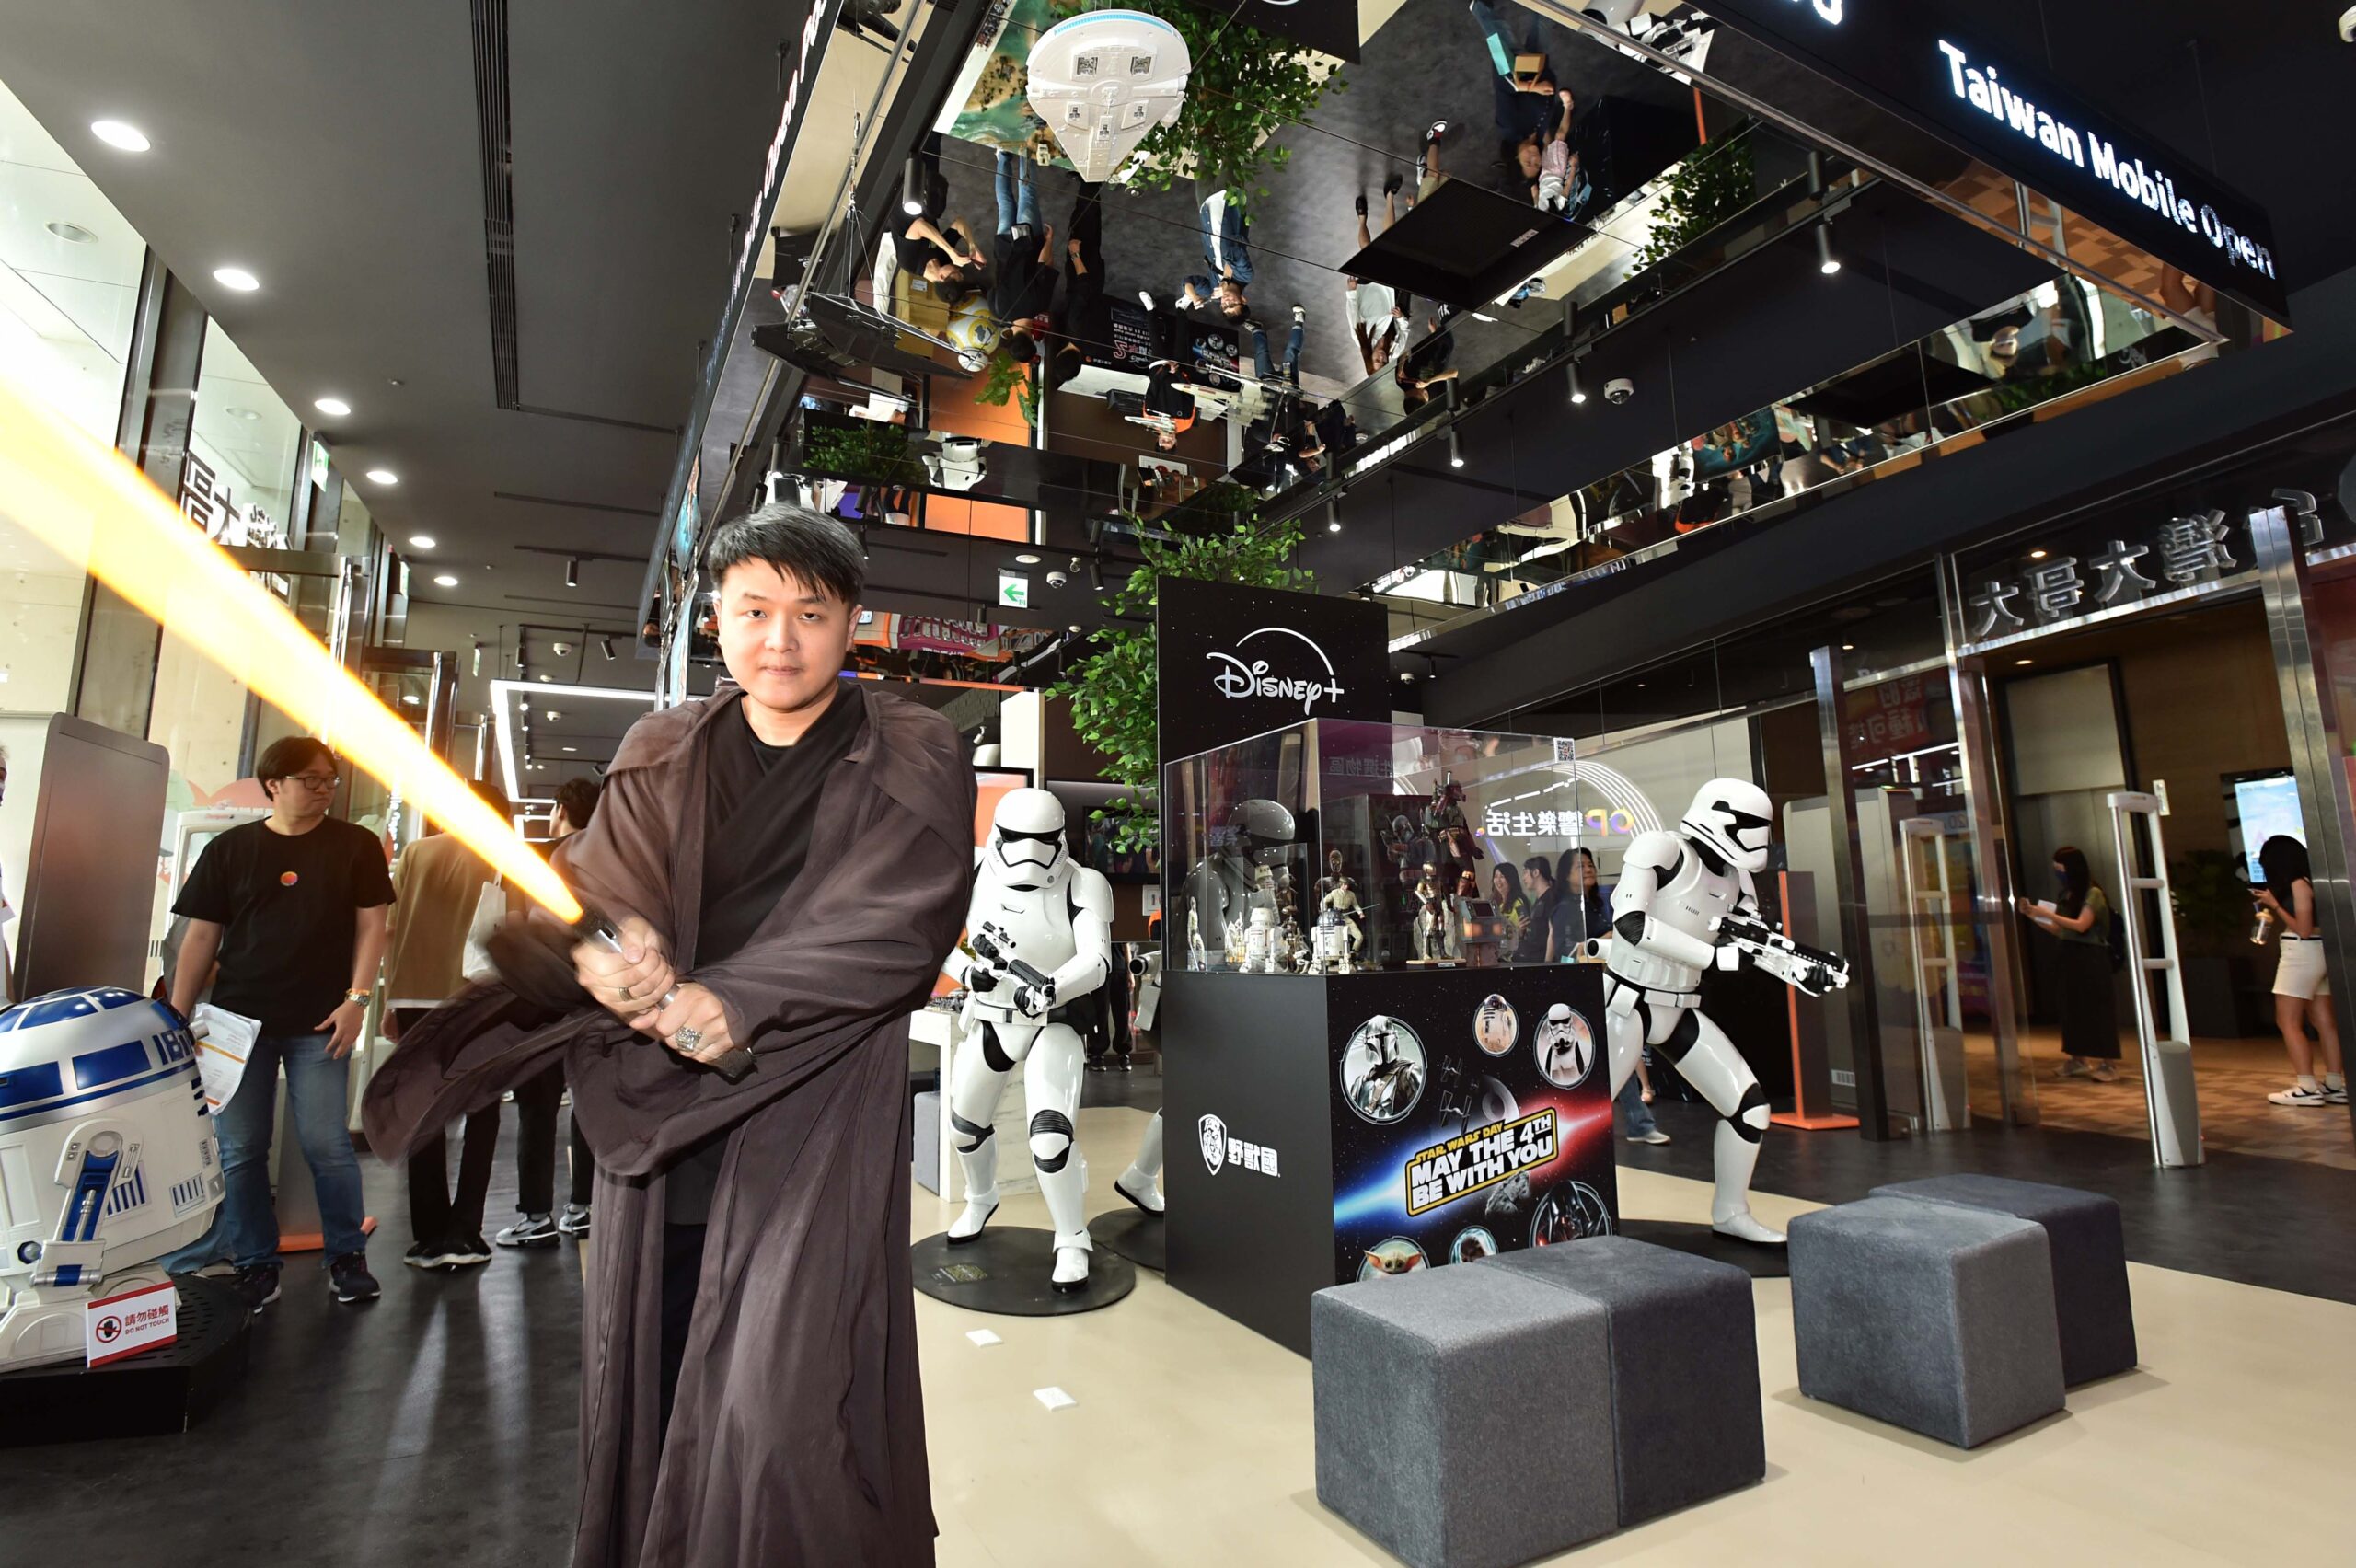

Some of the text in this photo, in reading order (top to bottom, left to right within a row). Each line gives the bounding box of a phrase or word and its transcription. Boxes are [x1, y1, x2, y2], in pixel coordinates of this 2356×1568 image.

[1938, 39, 2277, 281] Taiwan Mobile Open
[1206, 650, 1345, 716] Disney+
[1228, 1136, 1278, 1178] 野獸國
[1412, 1147, 1463, 1189] MAY
[1469, 1128, 1515, 1164] THE
[1415, 1121, 1505, 1163] STAR WARS DAY
[1412, 1135, 1553, 1210] BE WITH YOU
[124, 1304, 170, 1327] 請勿碰觸
[125, 1318, 170, 1335] DO NOT TOUCH
